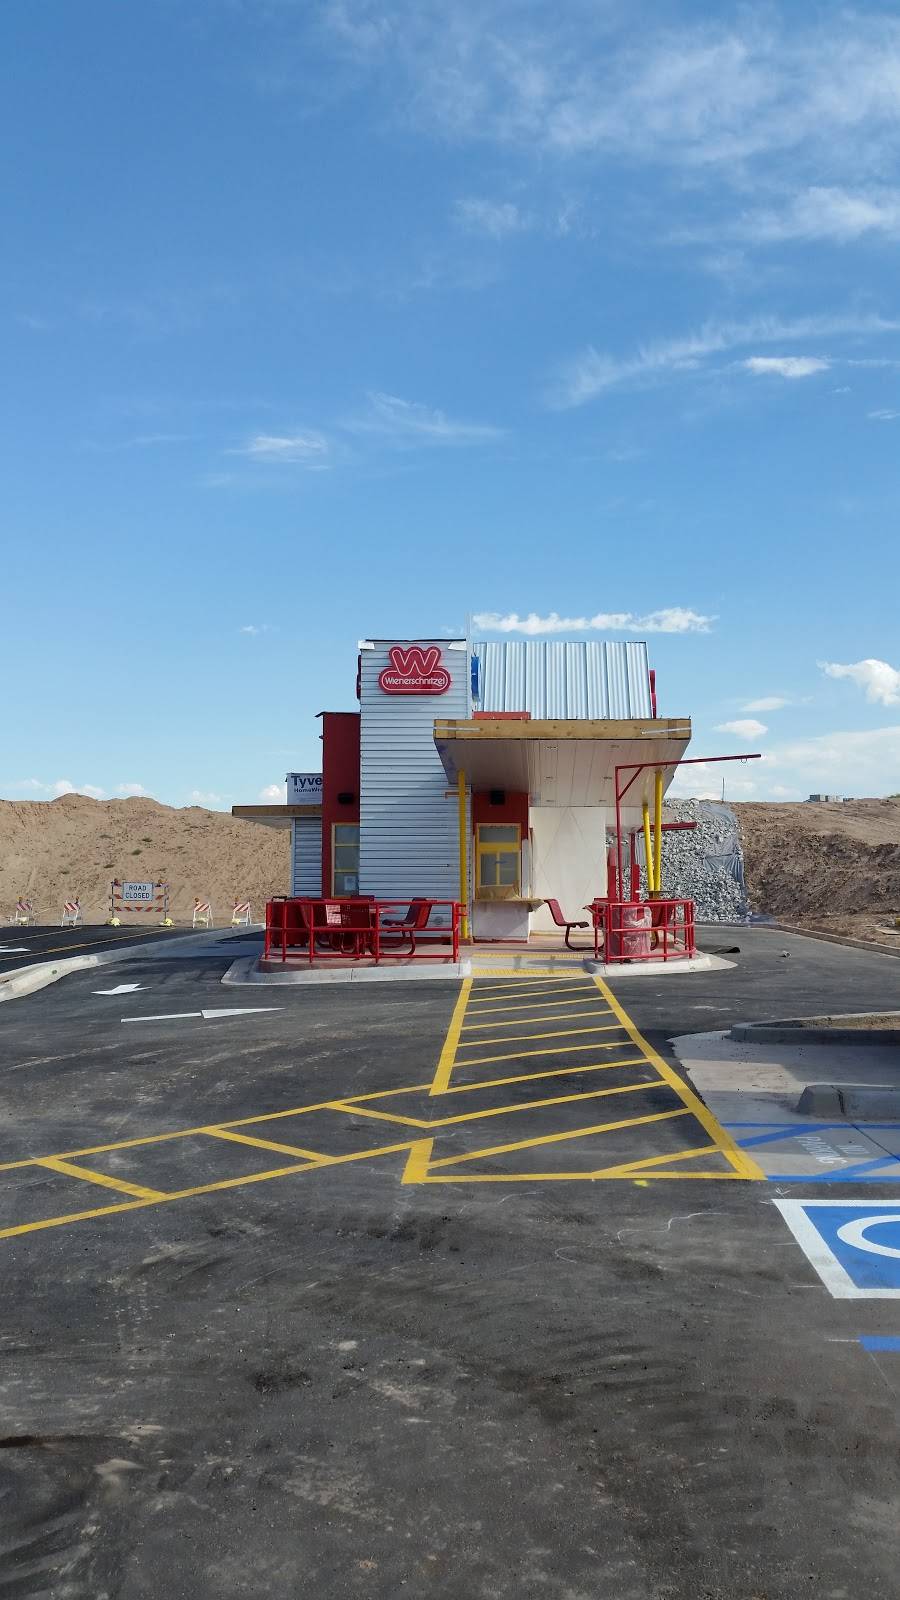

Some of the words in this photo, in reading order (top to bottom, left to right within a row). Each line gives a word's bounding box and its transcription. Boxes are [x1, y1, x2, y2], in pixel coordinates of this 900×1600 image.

[385, 677, 445, 687] Wienerschnitzel
[291, 776, 322, 788] Tyve
[793, 1136, 848, 1164] PARKING
